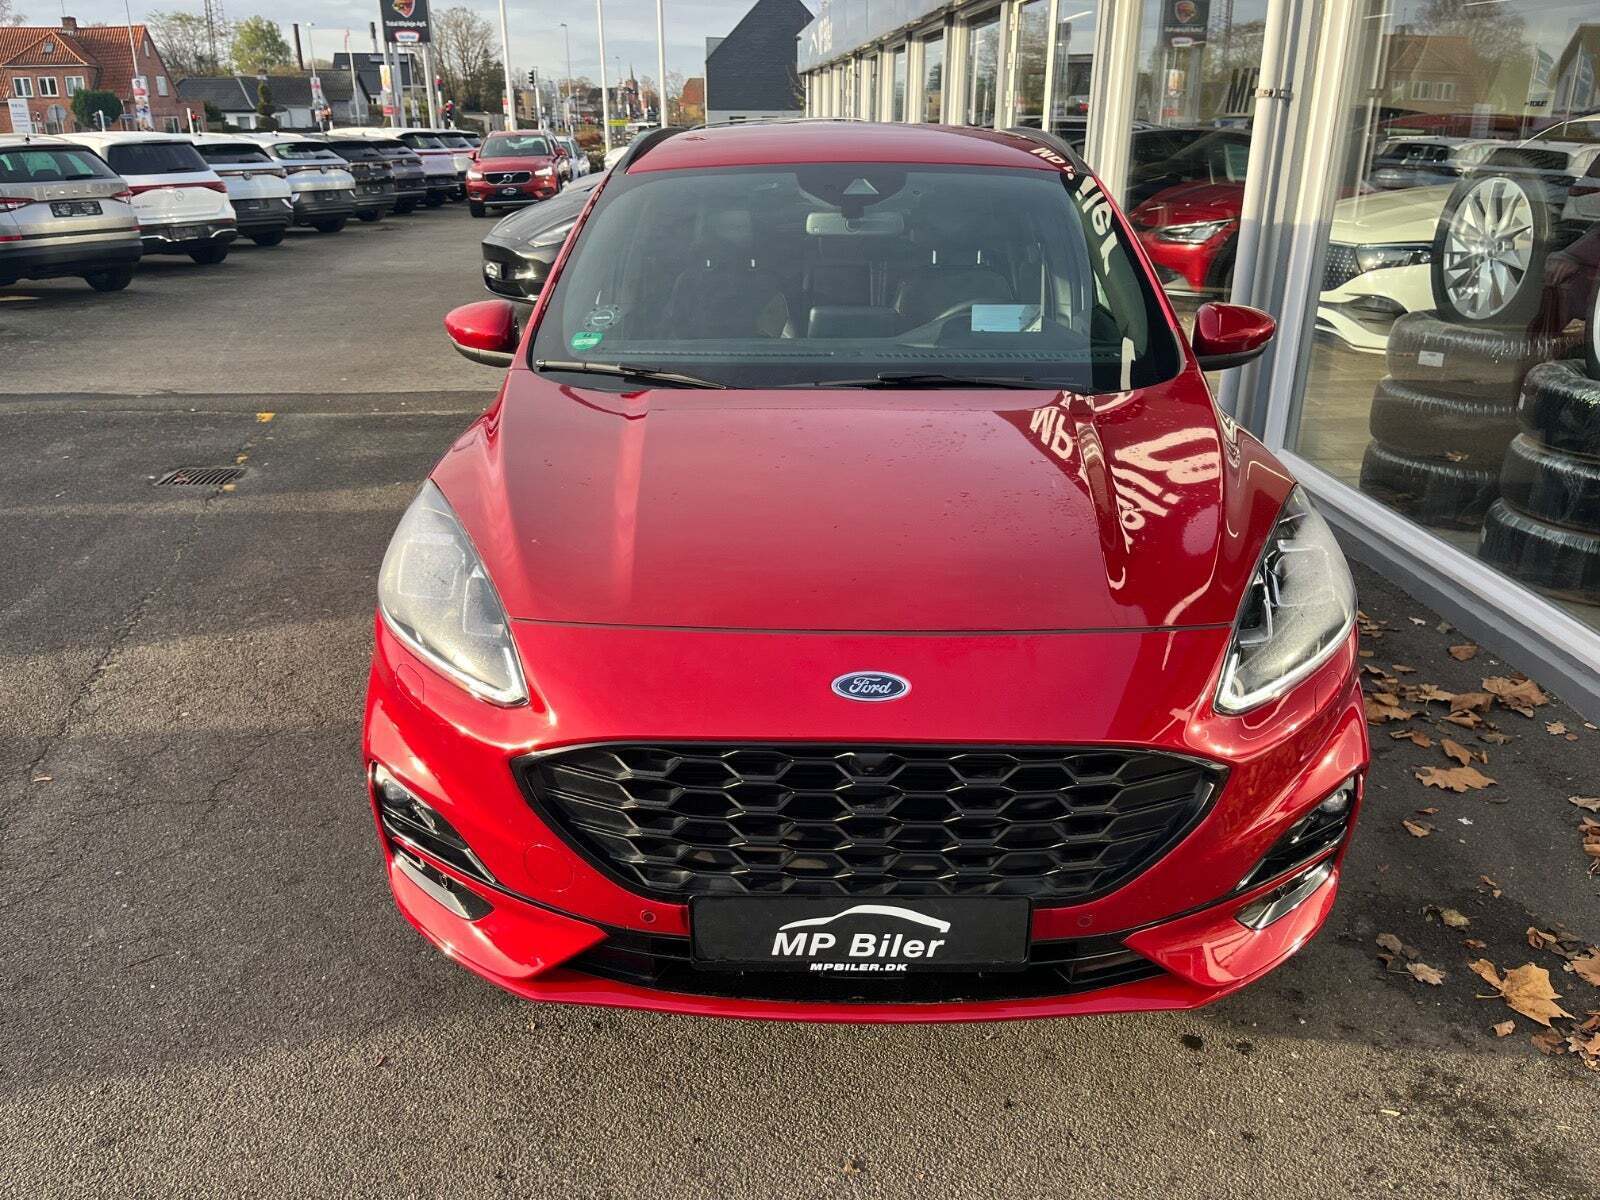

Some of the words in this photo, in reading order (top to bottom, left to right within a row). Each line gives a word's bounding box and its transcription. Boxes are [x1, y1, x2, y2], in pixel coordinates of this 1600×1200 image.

[848, 676, 893, 694] Ford
[771, 932, 837, 957] MP
[848, 932, 946, 959] Biler
[809, 962, 909, 973] MPBILER.DK
